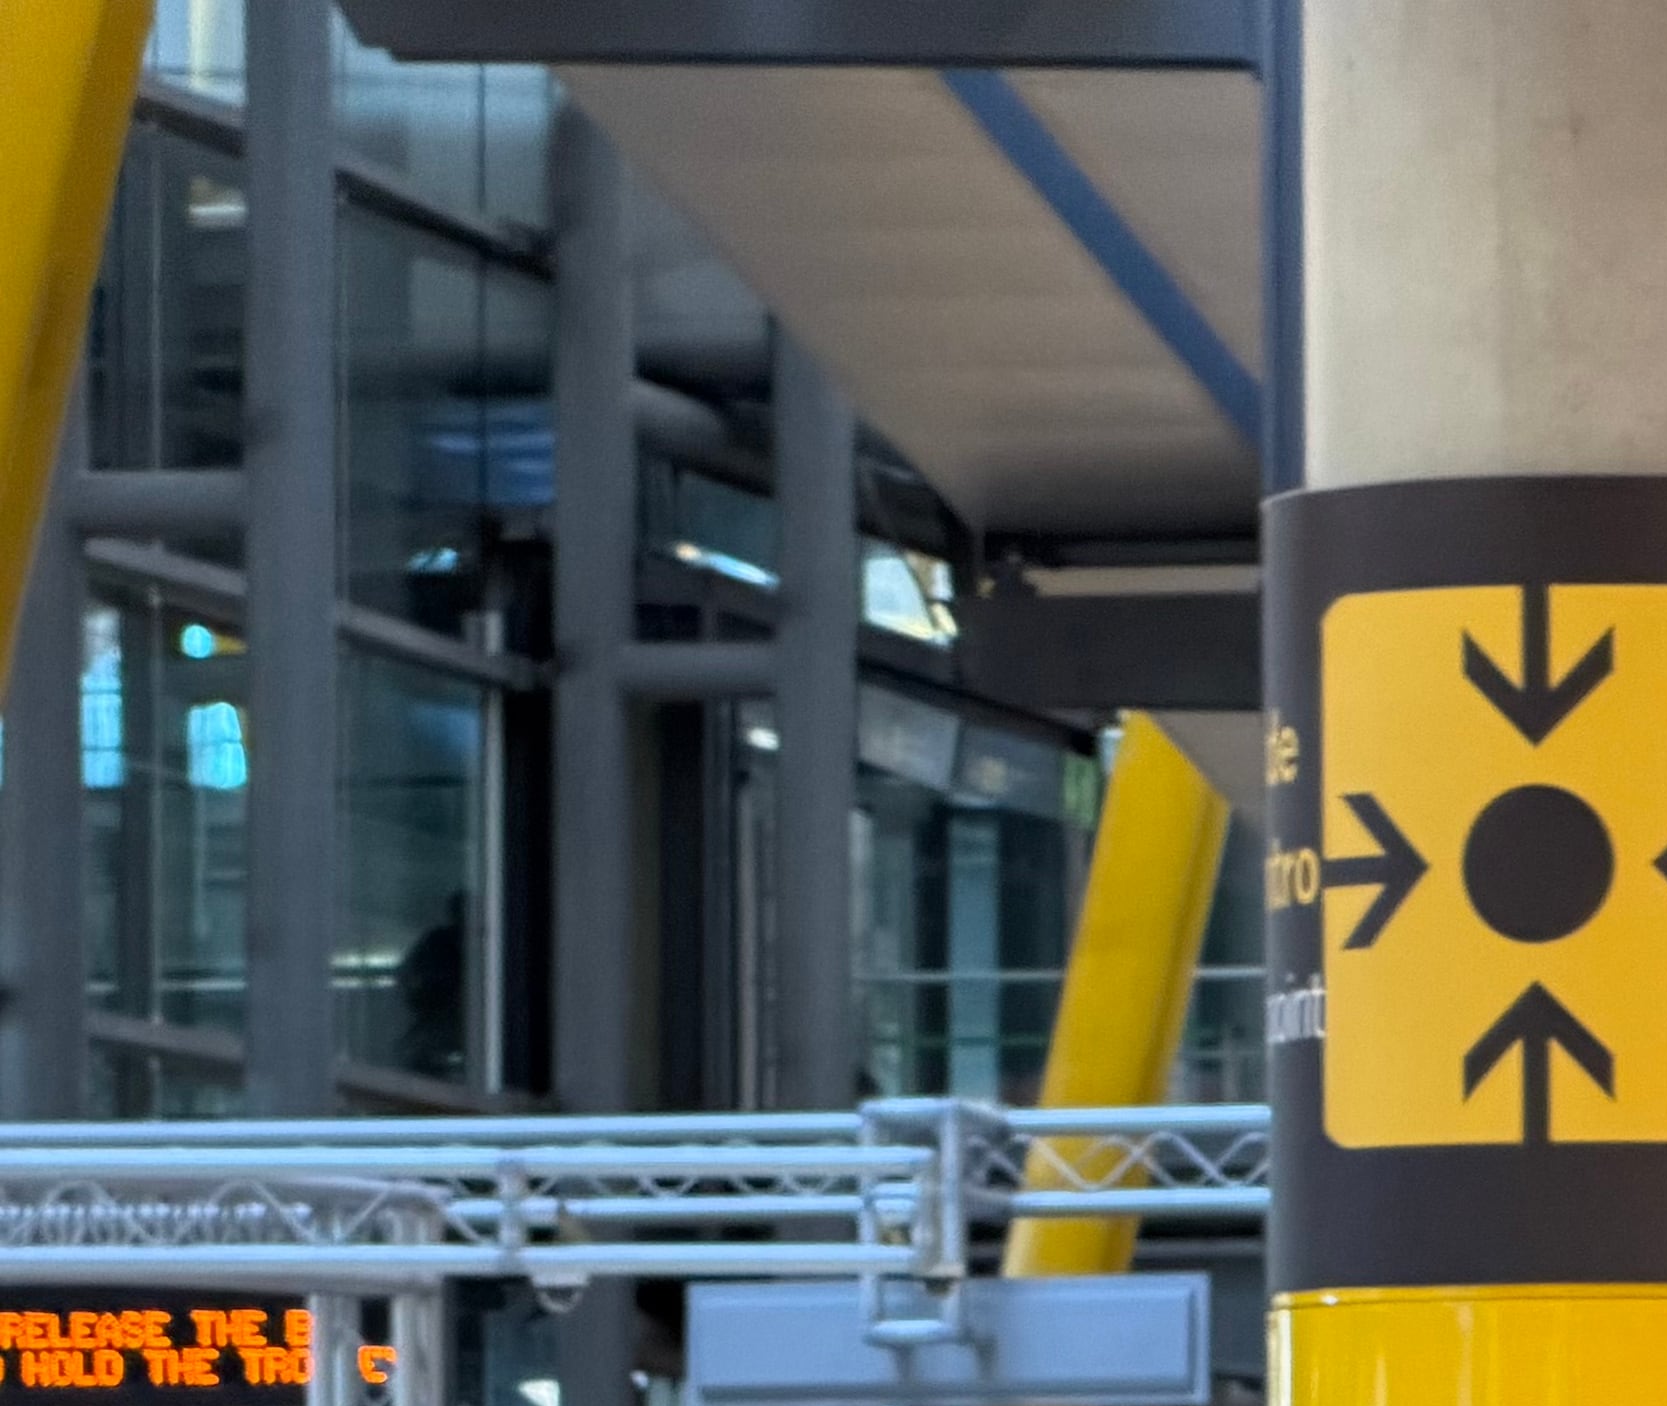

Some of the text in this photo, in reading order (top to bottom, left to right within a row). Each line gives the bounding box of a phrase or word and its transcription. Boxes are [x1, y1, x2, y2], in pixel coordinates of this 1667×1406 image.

[1265, 838, 1320, 912] tro
[0, 1310, 172, 1349] RELEASE
[190, 1309, 268, 1347] THE
[21, 1350, 125, 1387] HOLD
[142, 1348, 220, 1386] THE
